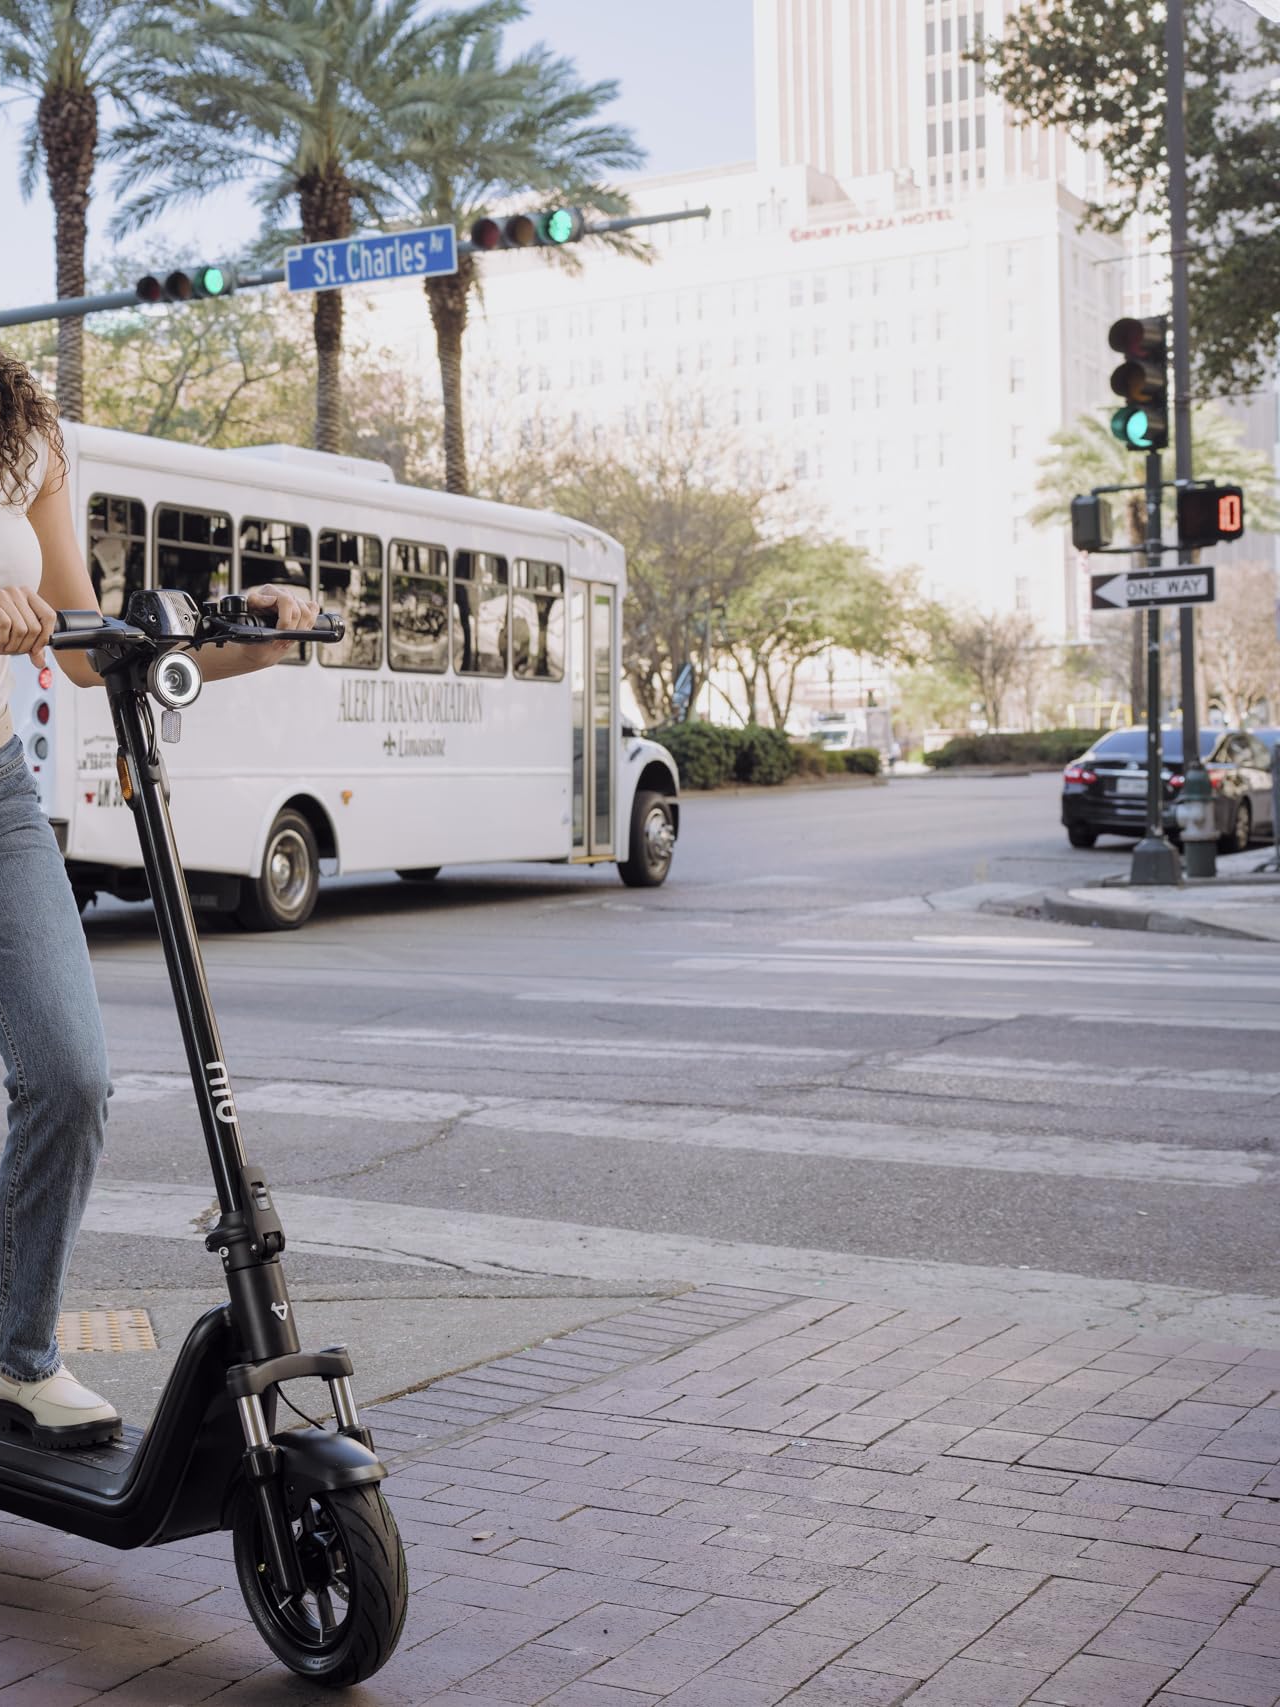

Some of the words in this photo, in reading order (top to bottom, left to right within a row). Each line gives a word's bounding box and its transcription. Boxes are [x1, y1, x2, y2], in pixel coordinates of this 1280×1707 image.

[847, 217, 895, 235] PLAZA
[901, 209, 955, 227] HOTEL
[312, 247, 345, 285] St.
[346, 238, 428, 281] Charles
[1126, 581, 1161, 598] ONE
[1167, 578, 1203, 594] WAY
[337, 679, 377, 723] ALERT
[380, 680, 484, 724] TRANSPORTATION
